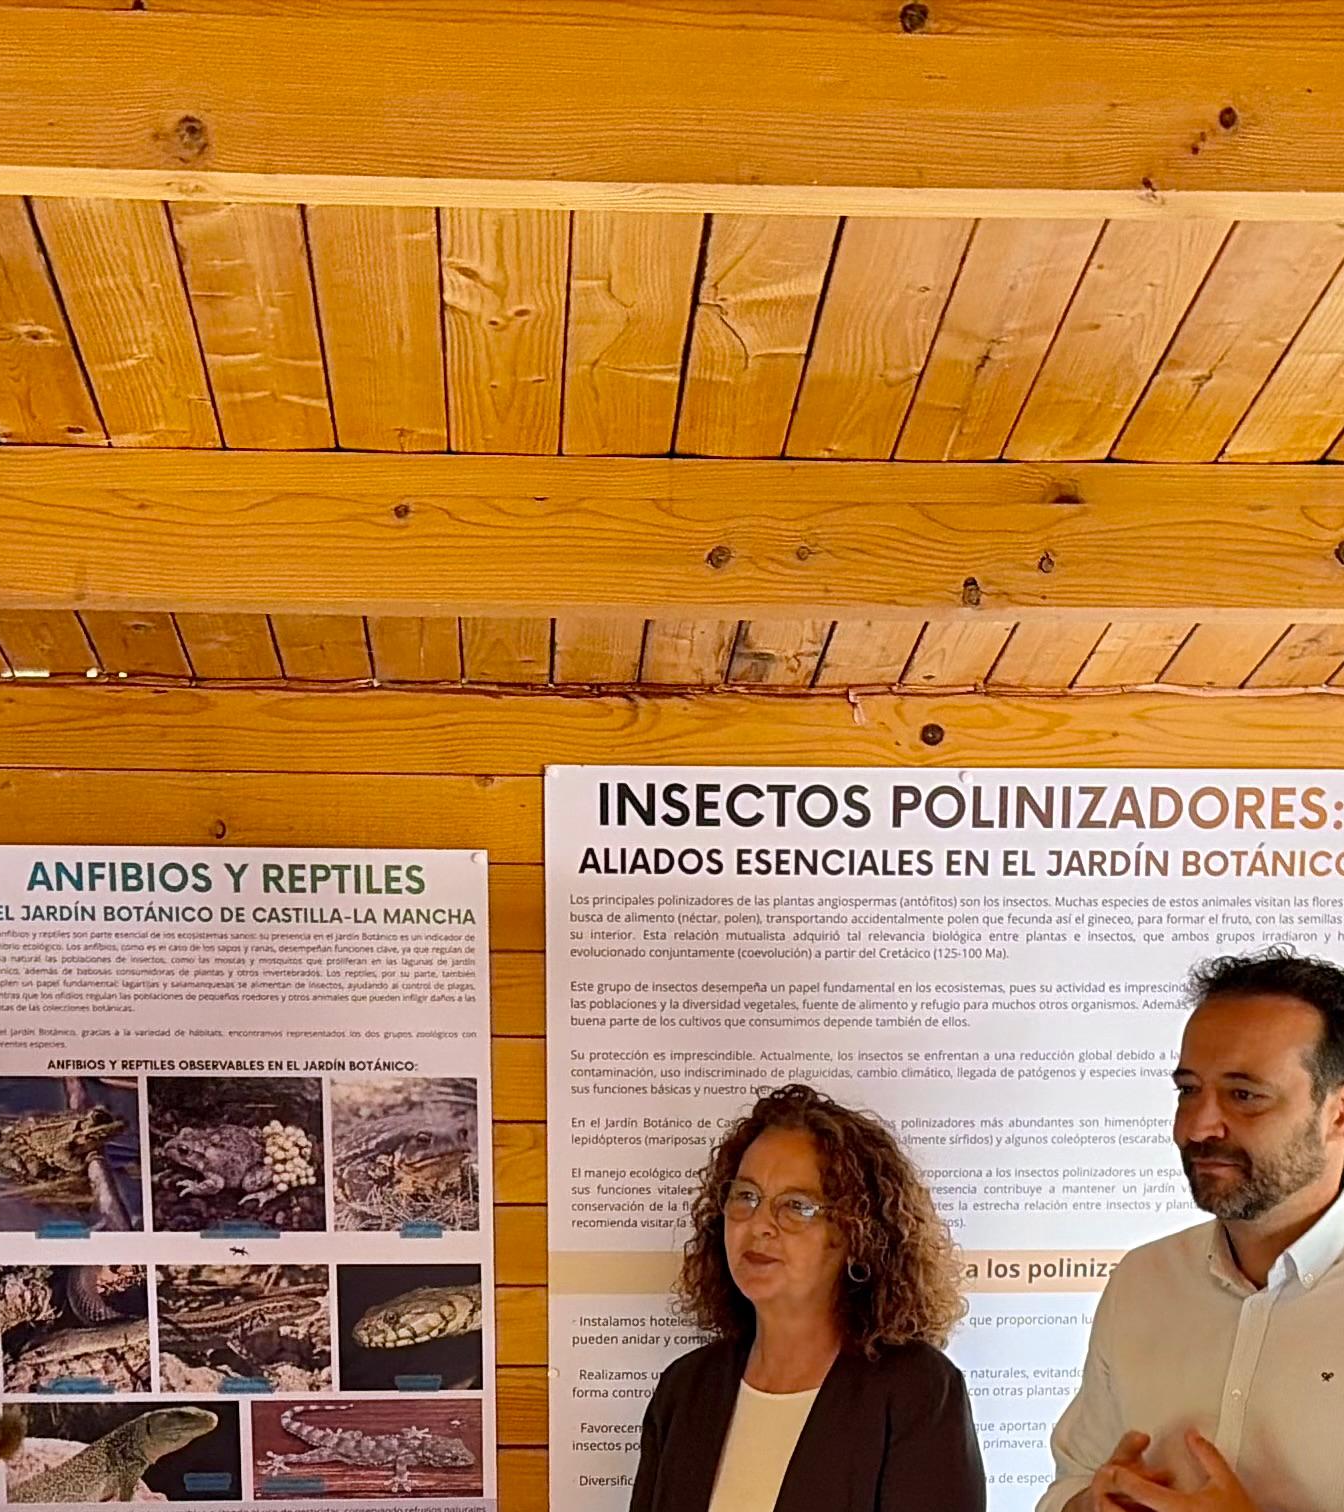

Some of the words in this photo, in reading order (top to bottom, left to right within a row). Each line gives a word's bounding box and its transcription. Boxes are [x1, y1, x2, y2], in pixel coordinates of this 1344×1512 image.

[600, 782, 870, 827] INSECTOS
[892, 784, 1344, 830] POLINIZADORES:
[578, 847, 723, 874] ALIADOS
[736, 848, 932, 875] ESENCIALES
[946, 850, 988, 875] EN
[1003, 850, 1035, 875] EL
[1046, 842, 1168, 876] JARDÍN
[26, 861, 212, 892] ANFIBIOS
[224, 863, 248, 892] Y
[262, 863, 424, 894] REPTILES
[569, 893, 590, 905] Los
[591, 893, 655, 908] principales
[656, 893, 734, 909] polinizadores
[734, 894, 752, 908] de
[753, 894, 770, 907] las
[772, 894, 815, 910] plantas
[816, 895, 897, 910] angiospermas
[898, 895, 958, 909] (antófitos)
[959, 897, 981, 907] son
[982, 895, 1000, 907] los
[1002, 895, 1052, 907] insectos.
[1054, 895, 1099, 907] Muchas
[1100, 895, 1149, 910] especies
[1151, 895, 1167, 907] de
[1168, 896, 1199, 908] estos
[1200, 895, 1252, 907] animales
[1253, 895, 1291, 907] visitan
[1292, 895, 1310, 908] las
[1311, 895, 1344, 908] flores
[19, 899, 96, 921] JARDÍN
[102, 900, 213, 923] BOTÁNICO
[220, 905, 246, 923] DE
[251, 906, 377, 924] CASTILLA-LA
[382, 907, 476, 925] MANCHA
[569, 910, 604, 923] busca
[605, 911, 621, 923] de
[623, 911, 675, 923] alimento
[676, 911, 721, 925] (néctar,
[723, 911, 763, 926] polen),
[765, 912, 848, 927] transportando
[850, 912, 944, 928] accidentalmente
[946, 912, 979, 927] polen
[981, 914, 1004, 927] que
[1006, 911, 1053, 925] fecunda
[1054, 912, 1072, 924] así
[1074, 912, 1085, 925] el
[1086, 912, 1134, 927] gineceo,
[1136, 914, 1163, 928] para
[1166, 912, 1206, 928] formar
[1207, 912, 1219, 925] el
[1220, 912, 1252, 925] fruto,
[1254, 914, 1276, 925] con
[1278, 913, 1295, 925] las
[1296, 912, 1343, 924] semillas
[569, 945, 646, 958] evolucionado
[648, 946, 736, 961] conjuntamente
[736, 946, 812, 960] (coevolución)
[813, 949, 822, 959] a
[823, 946, 857, 961] partir
[857, 946, 876, 959] del
[878, 946, 931, 959] Cretácico
[932, 946, 983, 960] (125-100
[984, 947, 1009, 960] Ma).
[46, 1058, 106, 1070] ANFIBIOS
[108, 1058, 118, 1070] Y
[120, 1058, 176, 1071] REPTILES
[178, 1059, 265, 1071] OBSERVABLES
[267, 1059, 284, 1071] EN
[286, 1059, 300, 1071] EL
[302, 1057, 346, 1071] JARDÍN
[348, 1057, 418, 1071] BOTÁNICO:
[964, 1263, 978, 1278] a
[986, 1257, 1020, 1278] los
[578, 1314, 646, 1327] Instalamos
[968, 1311, 992, 1328] que
[995, 1313, 1078, 1328] proporcionan
[571, 1332, 618, 1348] pueden
[620, 1332, 661, 1345] anidar
[662, 1335, 671, 1348] y
[578, 1368, 648, 1381] Realizamos
[969, 1366, 1029, 1379] naturales,
[571, 1386, 609, 1398] forma
[991, 1385, 1024, 1397] otras
[1025, 1383, 1070, 1399] plantas
[998, 1420, 1047, 1434] aportan
[571, 1439, 622, 1452] insectos
[982, 1437, 1047, 1451] primavera.
